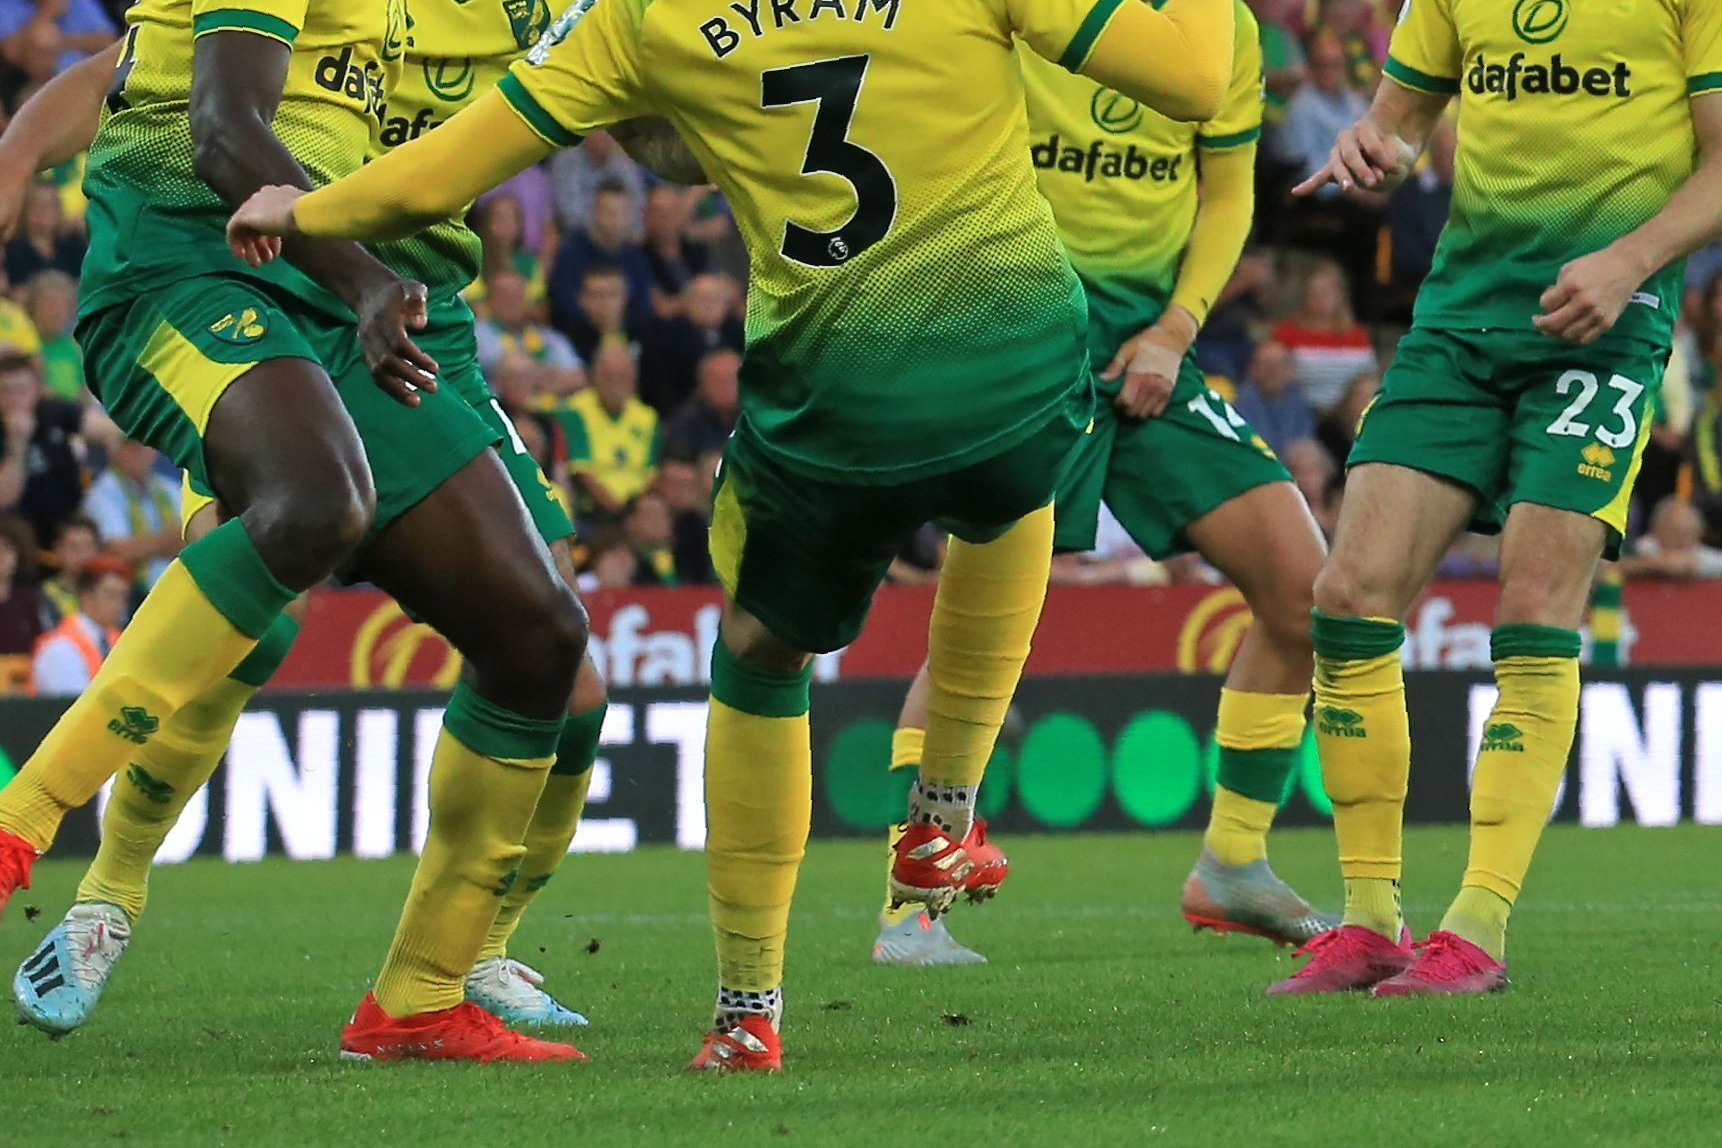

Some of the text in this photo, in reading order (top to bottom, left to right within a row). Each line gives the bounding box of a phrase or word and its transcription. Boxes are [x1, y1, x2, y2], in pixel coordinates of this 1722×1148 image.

[1468, 52, 1632, 102] dafabet
[760, 53, 898, 269] 3
[1030, 133, 1182, 183] dafabet
[1545, 368, 1645, 449] 23
[97, 698, 711, 866] NIT
